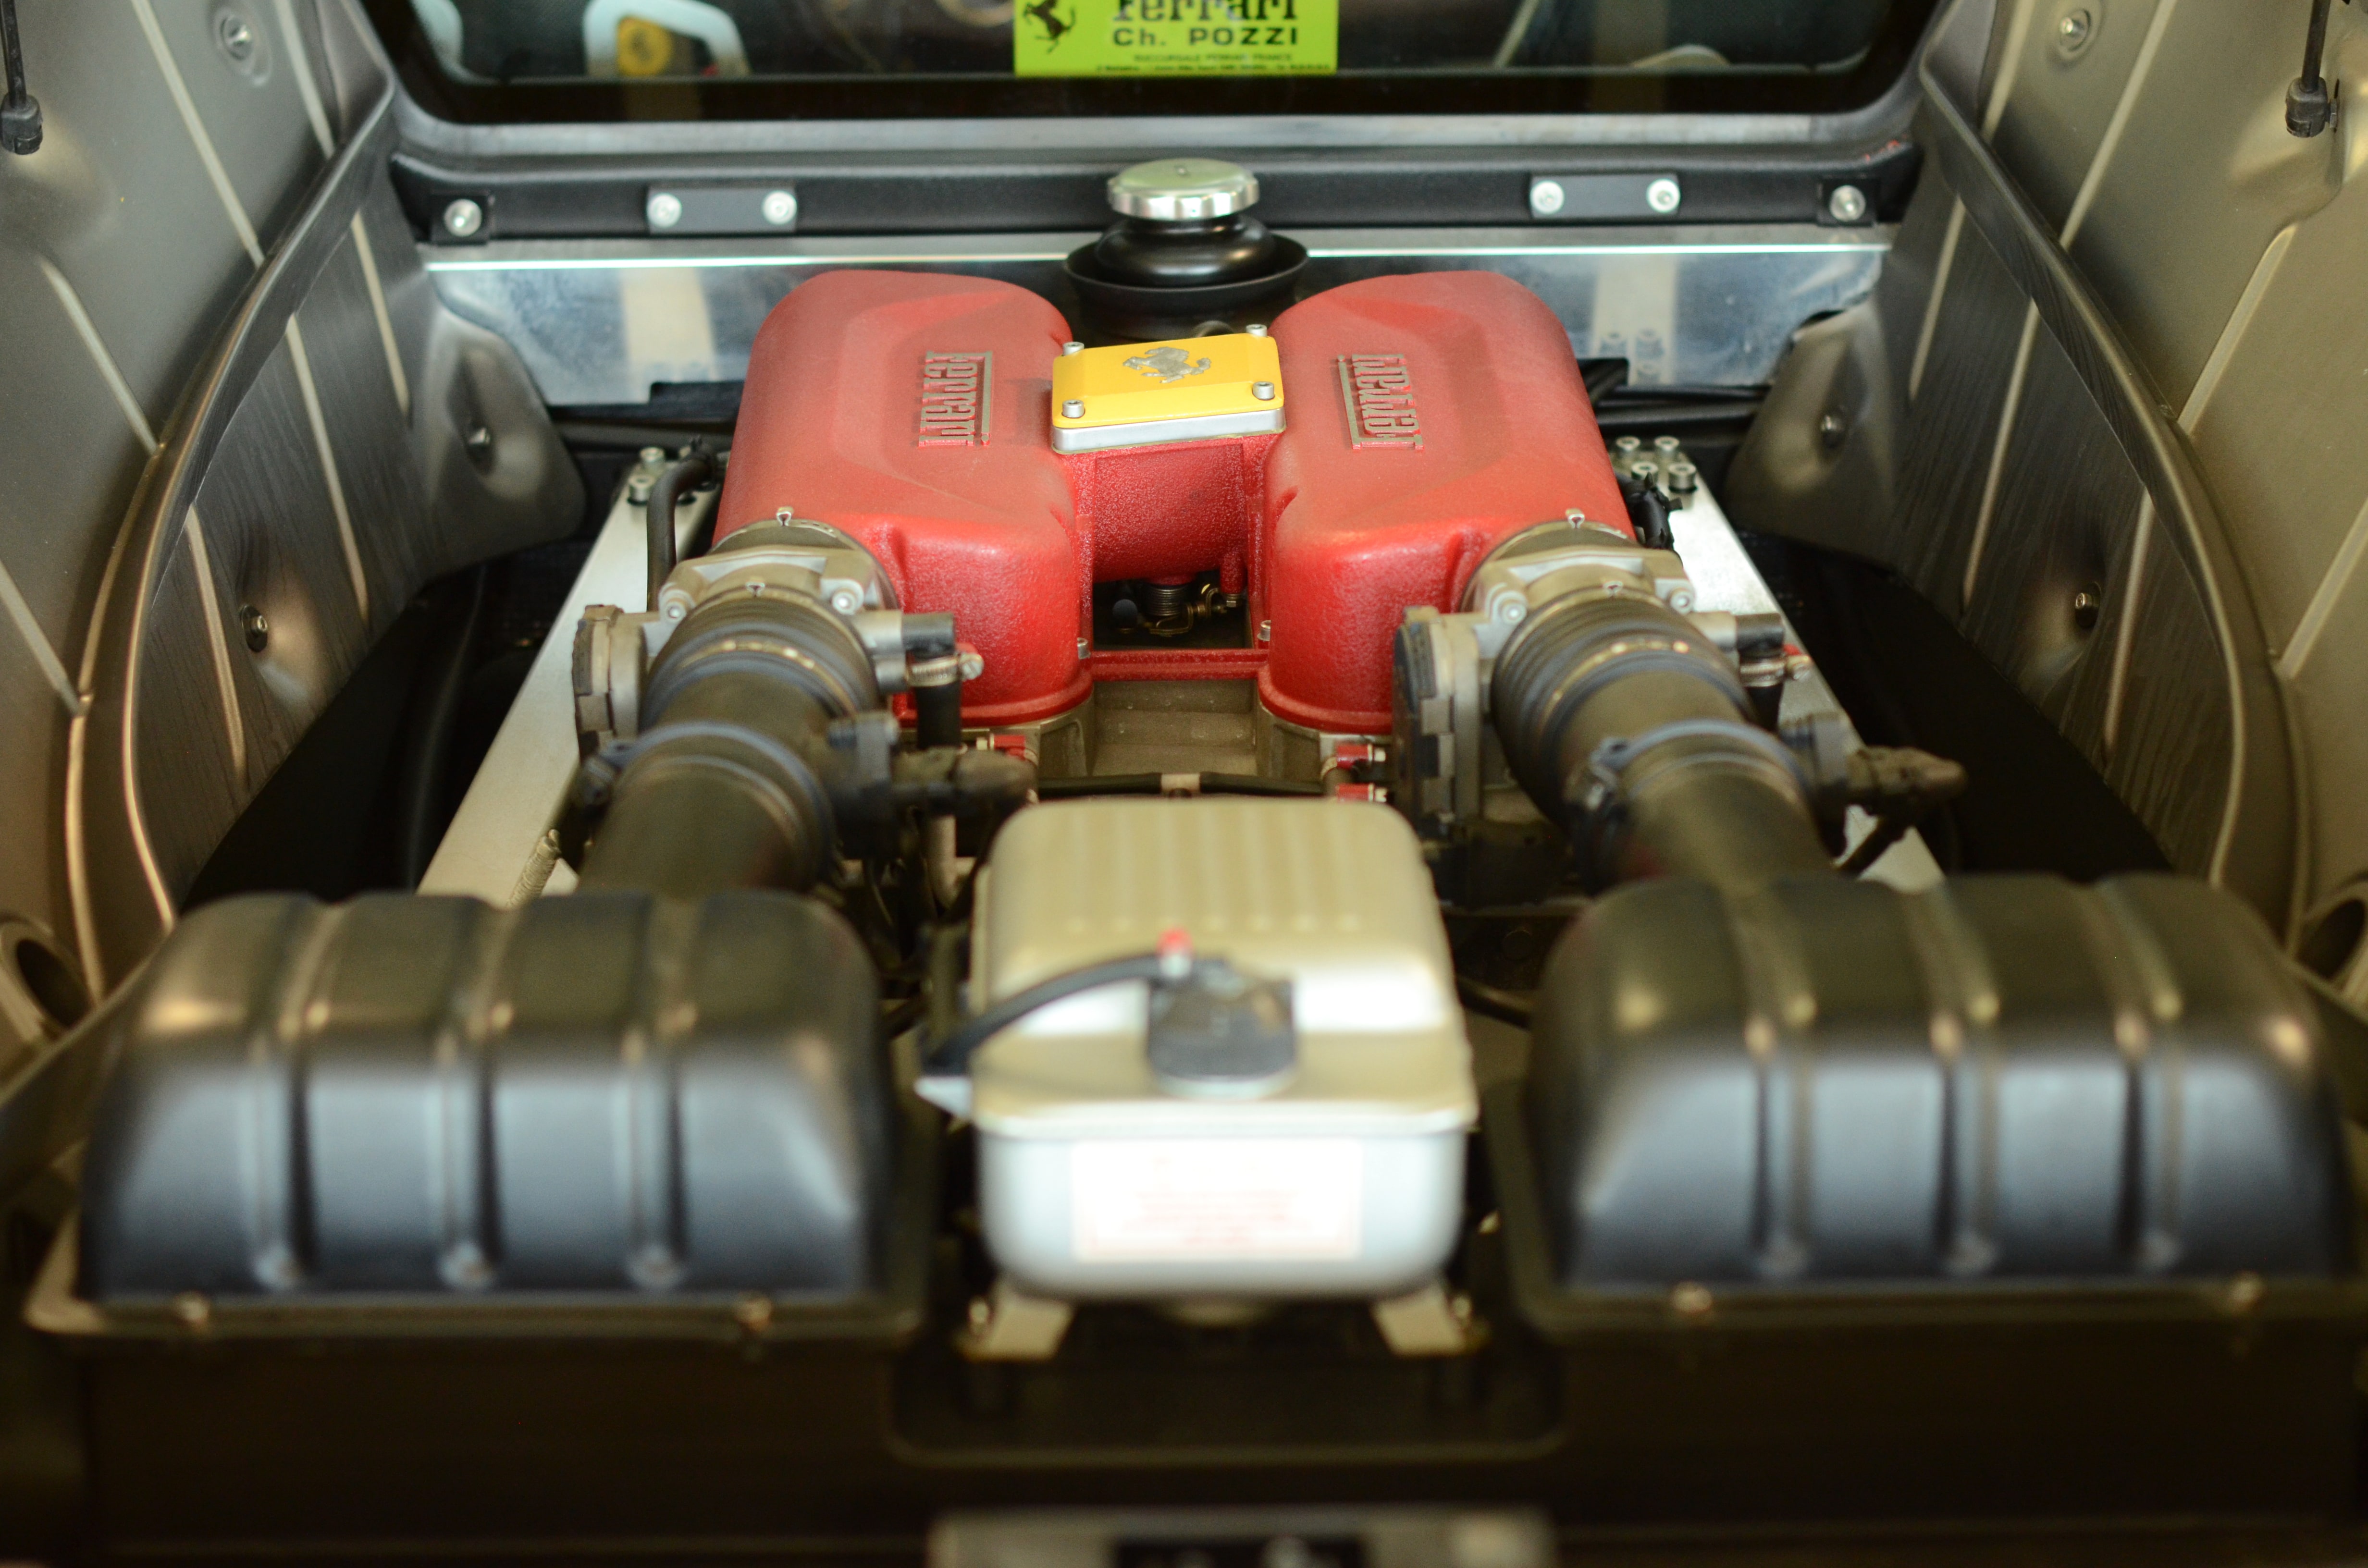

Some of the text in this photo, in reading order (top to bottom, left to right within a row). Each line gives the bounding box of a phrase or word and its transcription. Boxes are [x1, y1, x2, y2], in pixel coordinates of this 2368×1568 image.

[1113, 27, 1297, 46] Ch. POZZI
[919, 351, 993, 447] Ferrari
[1337, 353, 1424, 450] Ferrari
